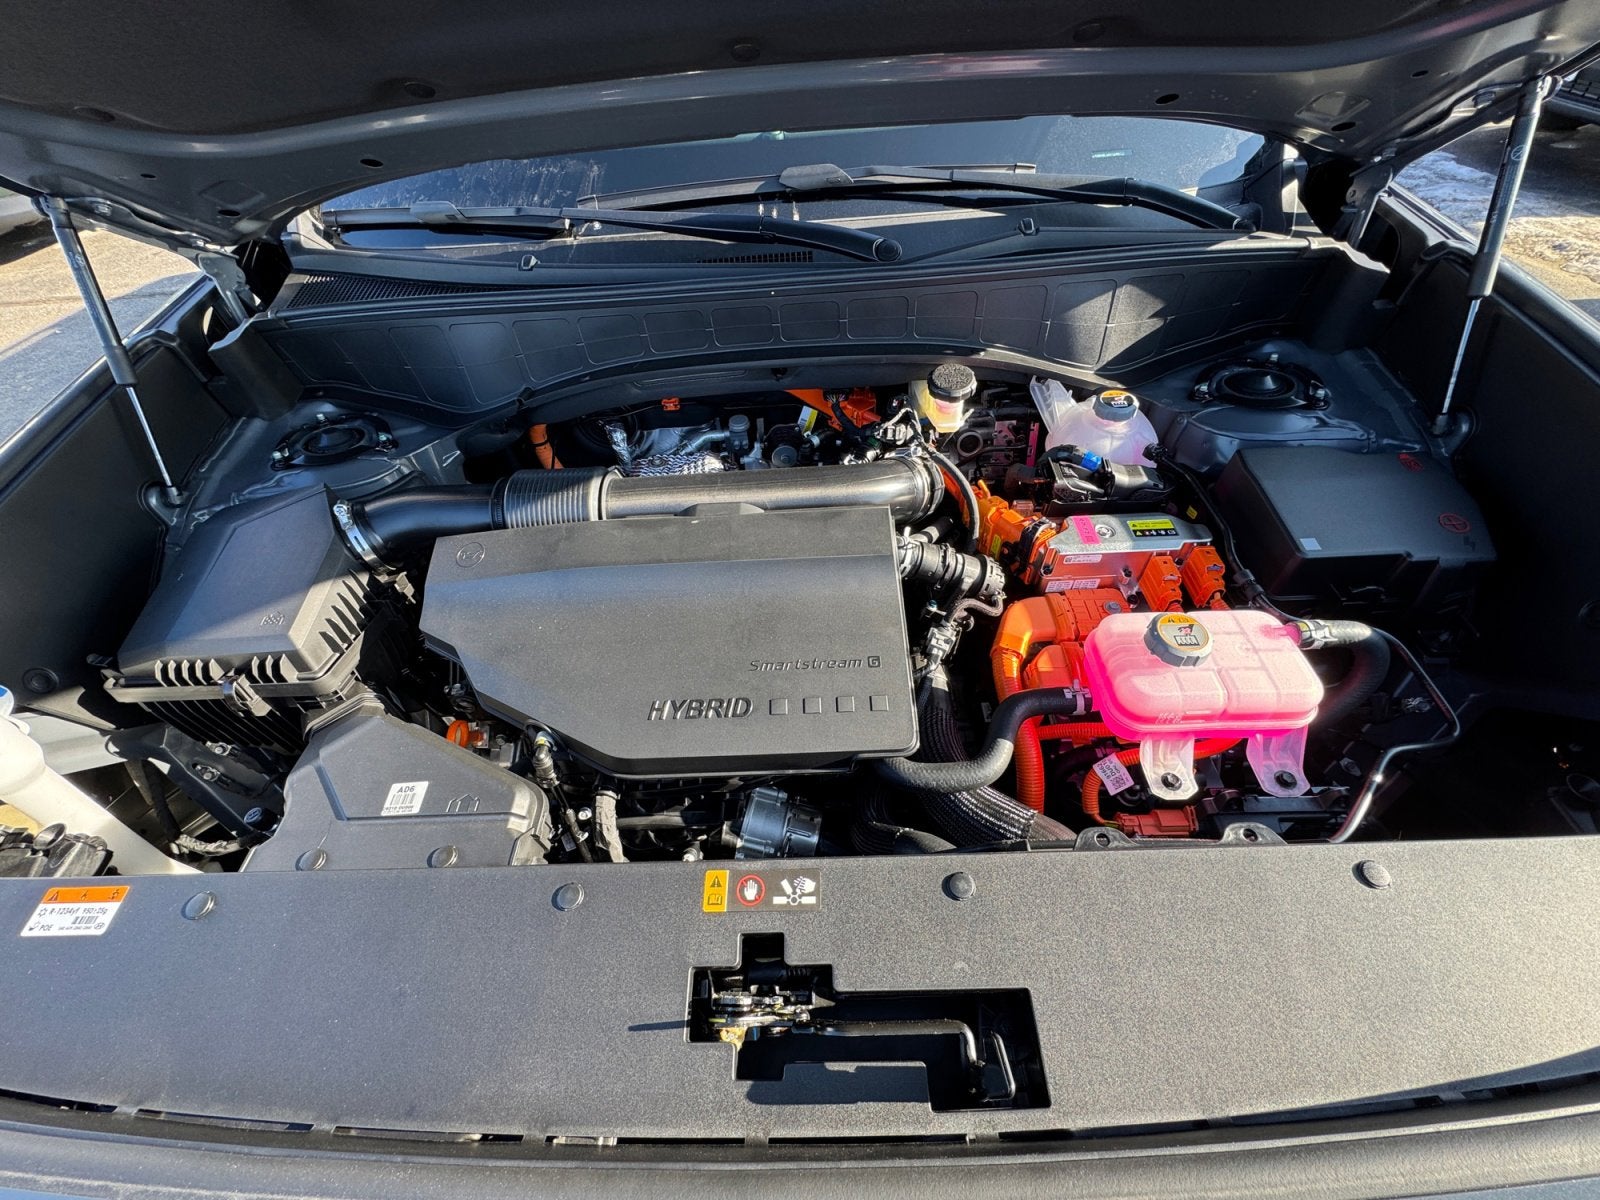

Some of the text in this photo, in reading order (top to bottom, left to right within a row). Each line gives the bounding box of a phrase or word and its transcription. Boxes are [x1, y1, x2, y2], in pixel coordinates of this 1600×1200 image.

[750, 655, 881, 671] Smartstream G
[647, 697, 754, 720] HYBRID
[396, 785, 416, 794] AD6
